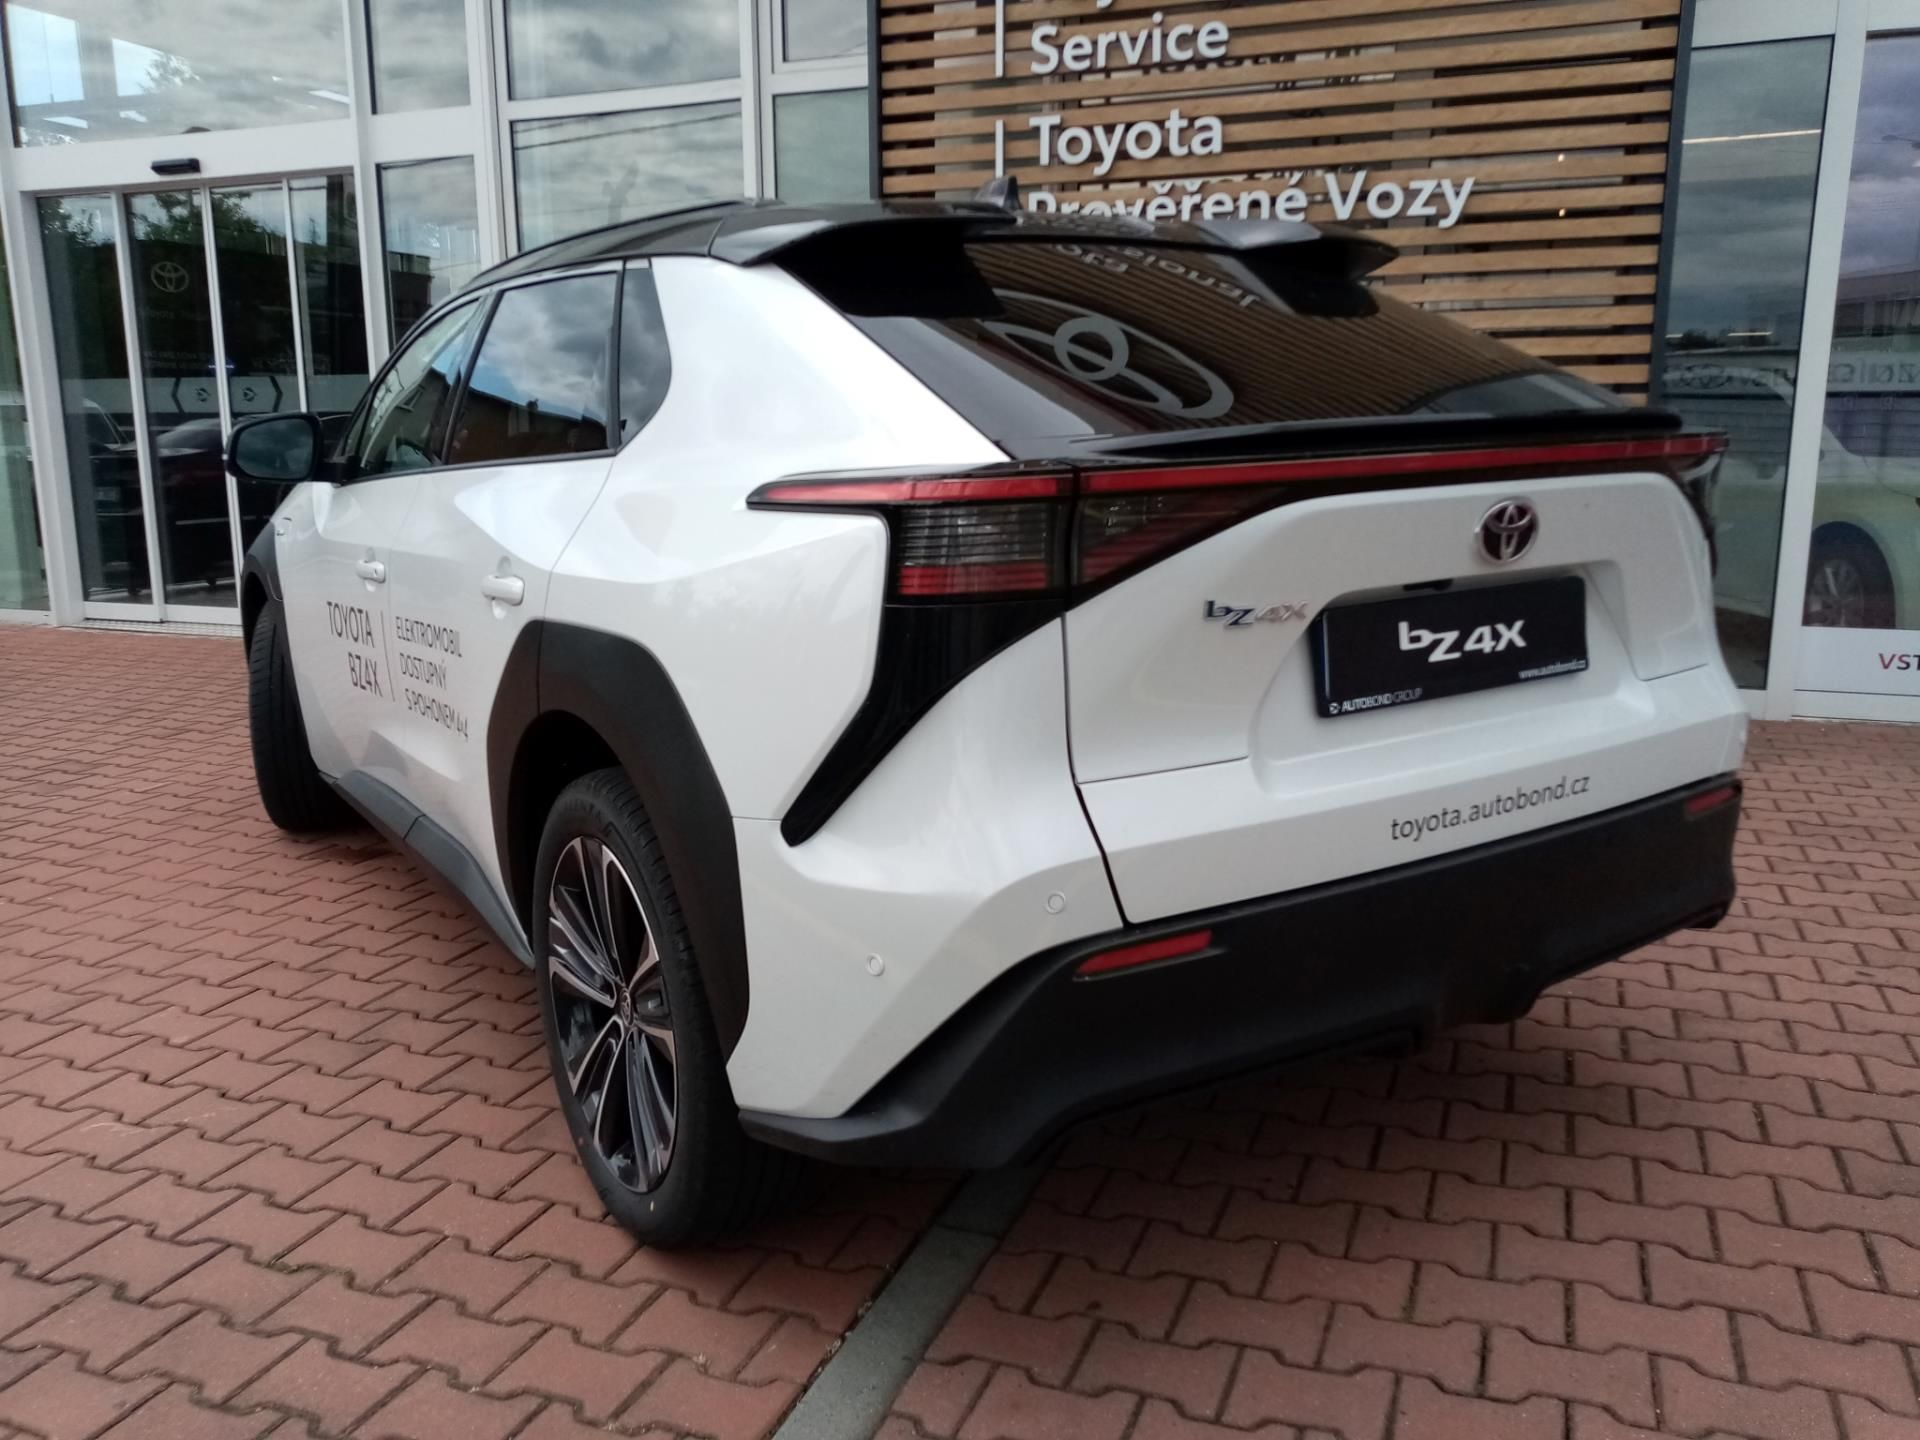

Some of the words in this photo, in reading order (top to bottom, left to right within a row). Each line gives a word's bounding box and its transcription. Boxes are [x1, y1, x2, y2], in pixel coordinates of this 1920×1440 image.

[1030, 12, 1229, 74] Service
[1029, 109, 1223, 175] Toyota
[1028, 170, 1308, 222] ěřené
[1325, 170, 1475, 229] Vozy
[326, 600, 375, 648] TOYOTA
[348, 652, 383, 697] BZ4X
[1390, 775, 1591, 842] toyota.autobond.cz
